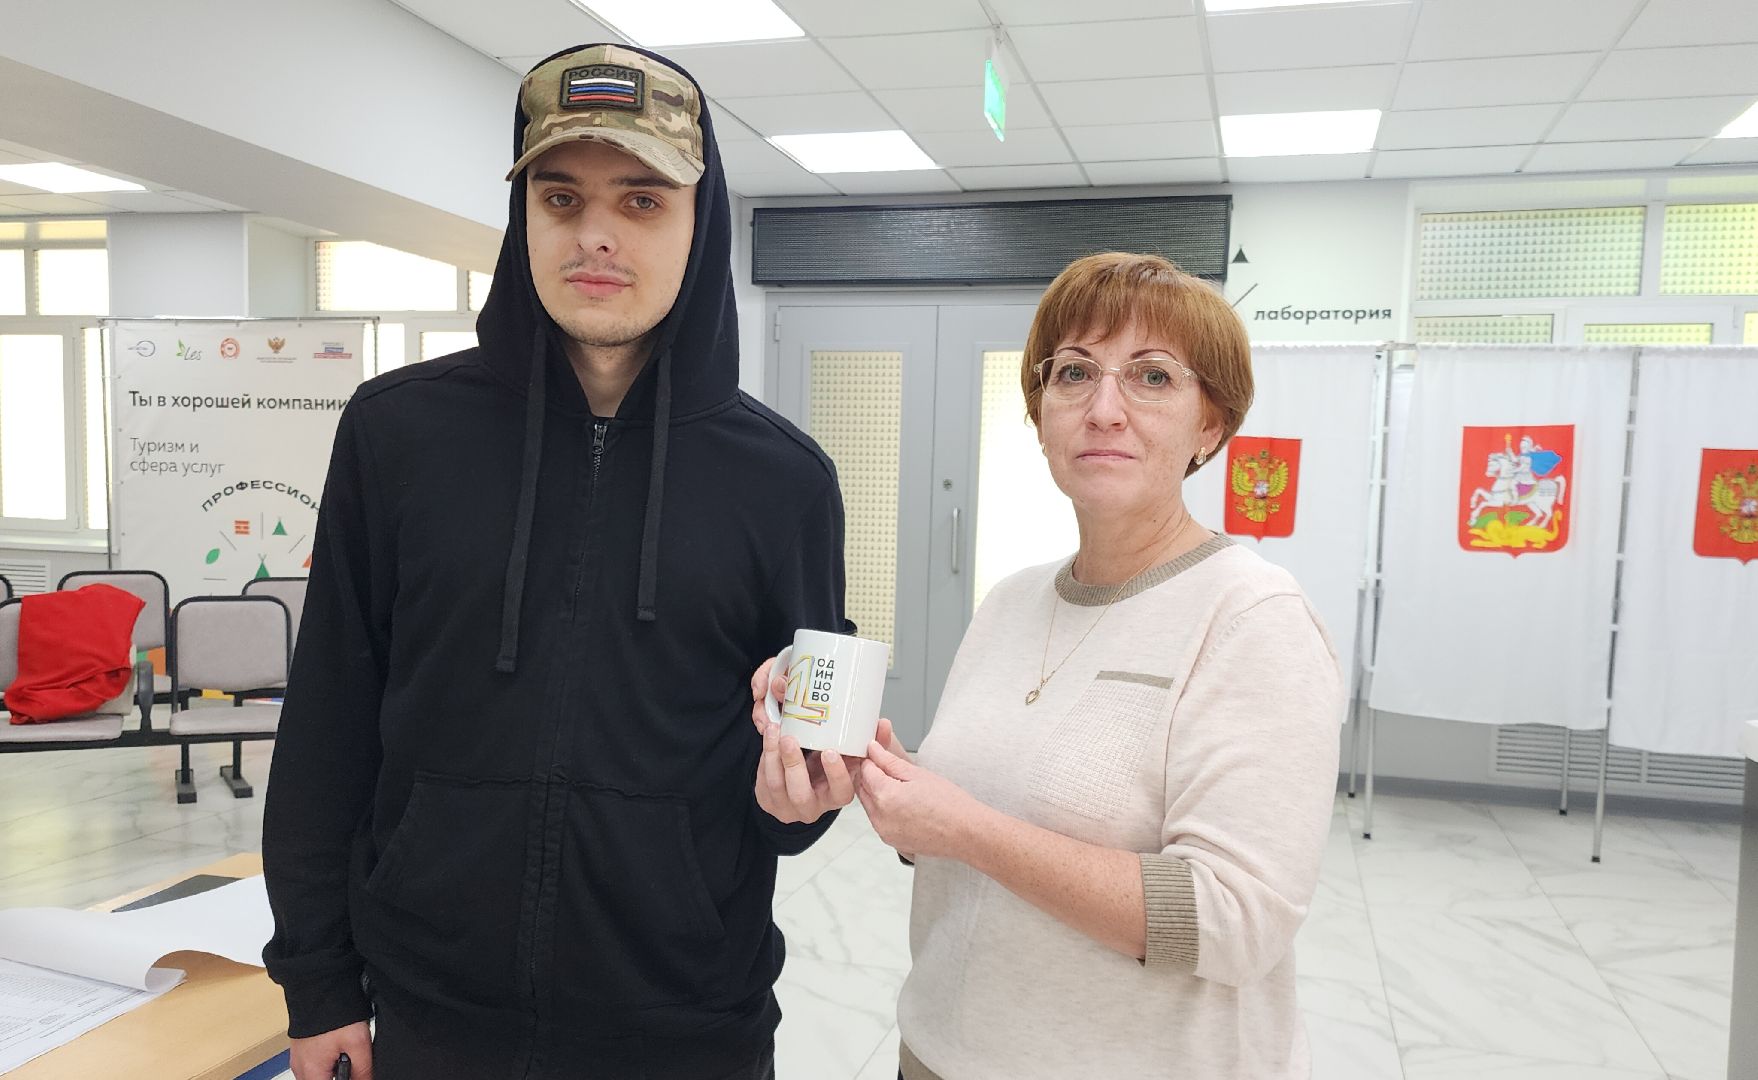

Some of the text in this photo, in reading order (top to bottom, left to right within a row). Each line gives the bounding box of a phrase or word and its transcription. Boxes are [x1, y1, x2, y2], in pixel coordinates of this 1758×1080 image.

[568, 67, 640, 81] РОССИЯ
[1254, 305, 1392, 325] лаборатория
[129, 391, 152, 407] Ты
[157, 396, 166, 407] в
[171, 394, 251, 412] хорошей
[130, 437, 200, 456] Туризм и
[130, 457, 225, 477] сфера услуг
[817, 658, 835, 669] ОД
[815, 669, 834, 681] ИН
[813, 680, 832, 692] ЦО
[811, 691, 830, 703] ВО
